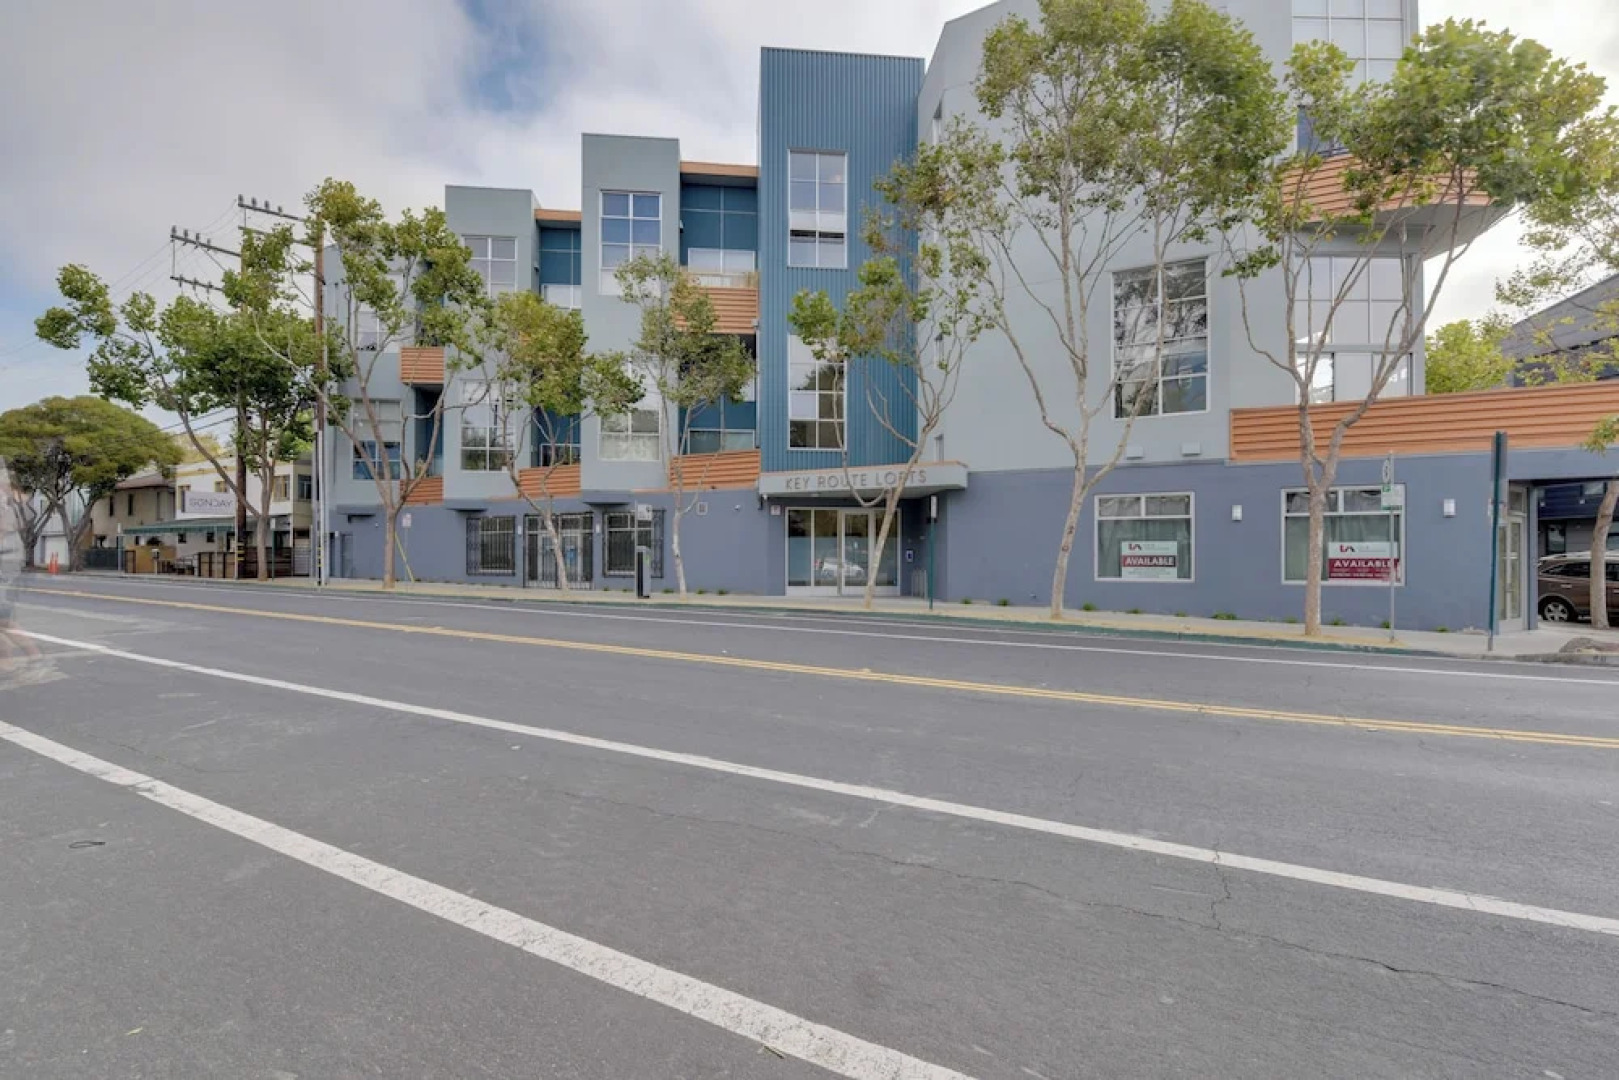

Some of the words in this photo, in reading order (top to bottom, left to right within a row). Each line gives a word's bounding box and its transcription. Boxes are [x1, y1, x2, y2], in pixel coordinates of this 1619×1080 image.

[786, 476, 809, 489] KEY
[817, 473, 866, 488] ROUTE
[1126, 557, 1174, 565] AVAILABLE
